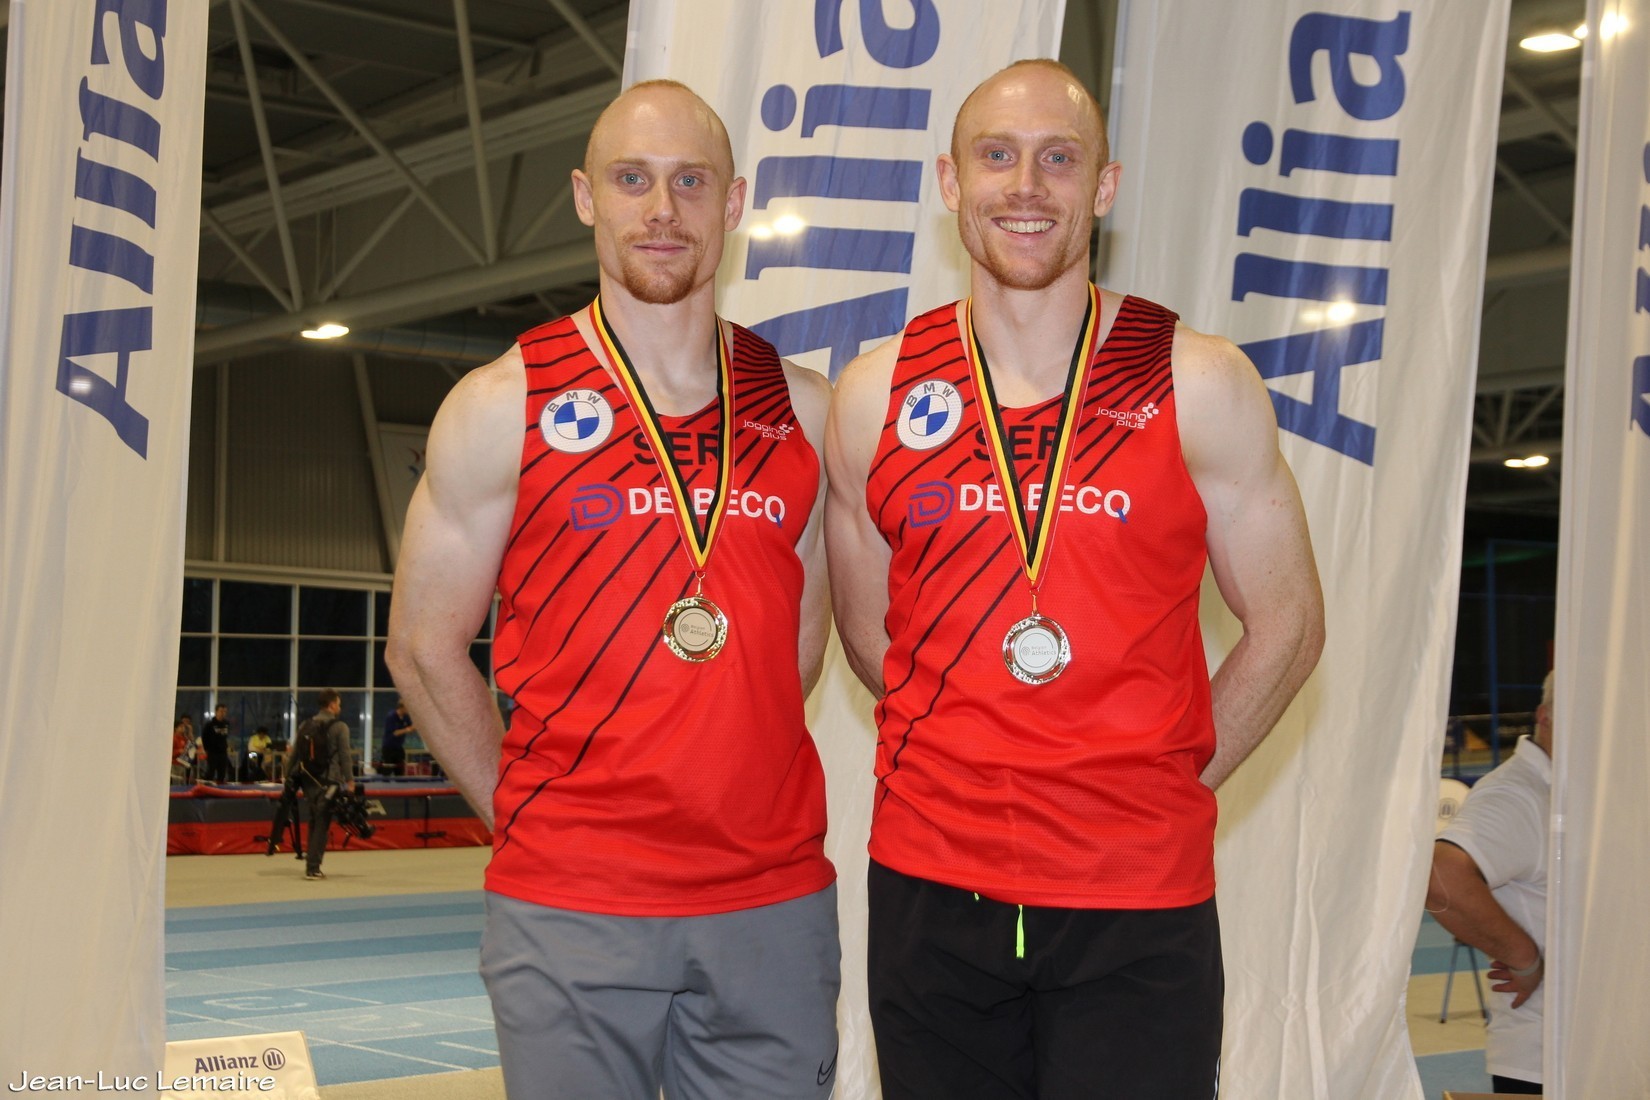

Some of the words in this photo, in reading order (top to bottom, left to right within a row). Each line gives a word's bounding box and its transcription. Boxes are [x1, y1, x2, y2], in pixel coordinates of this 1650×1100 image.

[1231, 11, 1411, 466] Allia
[547, 391, 601, 413] BMW
[906, 382, 955, 408] BMW
[762, 431, 787, 441] plus
[1116, 420, 1146, 430] plus
[628, 486, 786, 529] DEBECQ
[959, 484, 1131, 524] DEBECQ
[195, 1055, 259, 1074] Allianz
